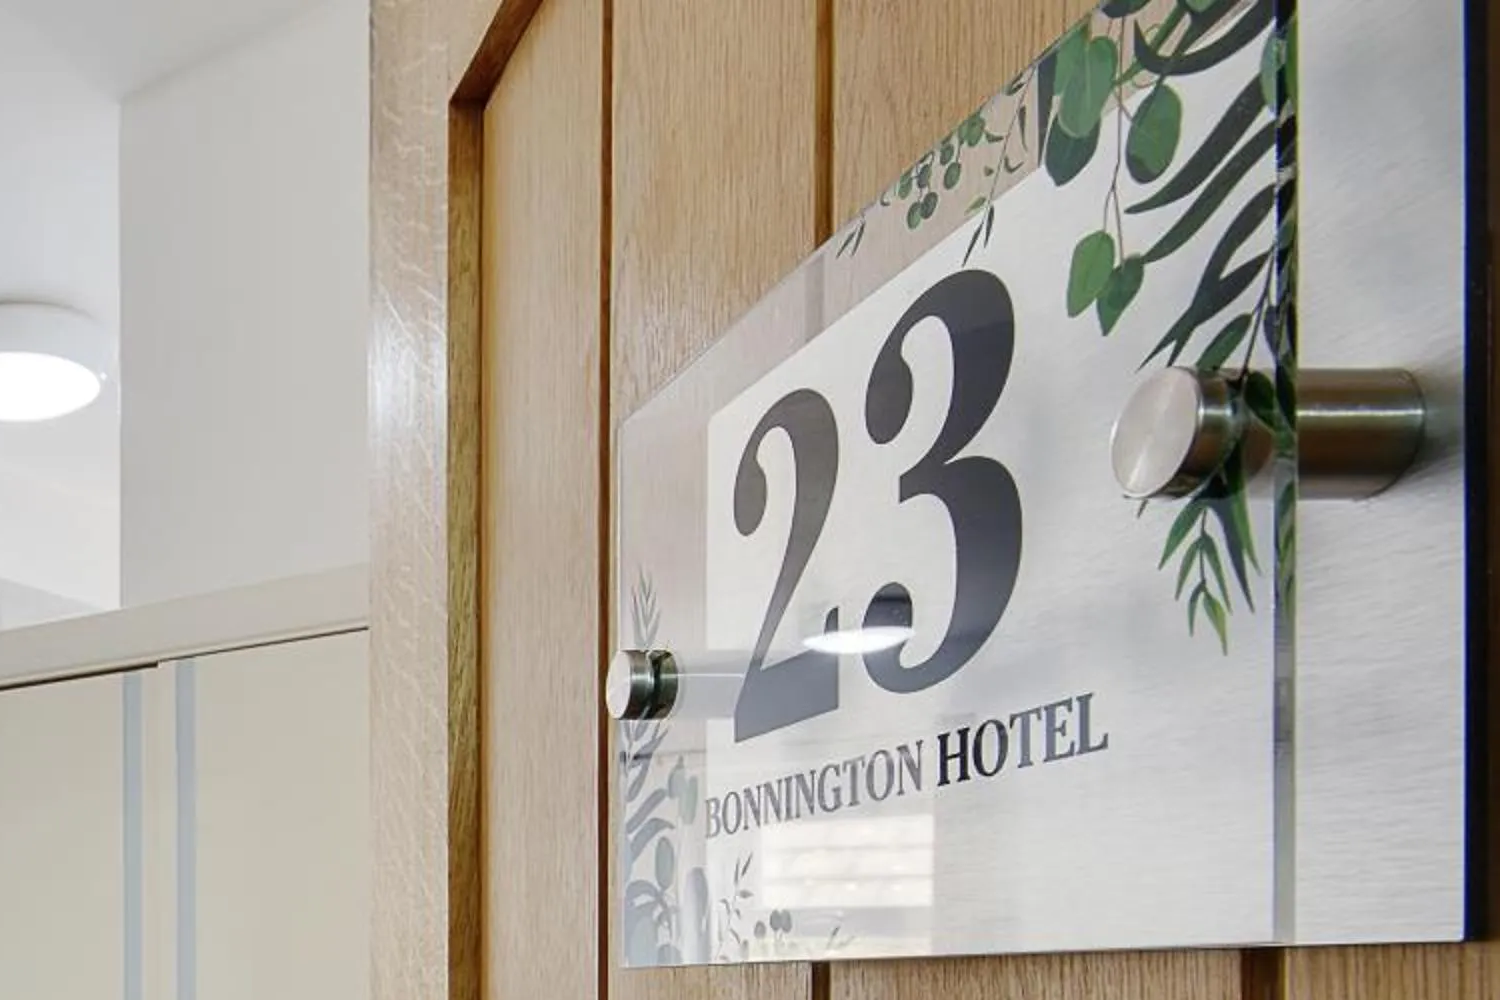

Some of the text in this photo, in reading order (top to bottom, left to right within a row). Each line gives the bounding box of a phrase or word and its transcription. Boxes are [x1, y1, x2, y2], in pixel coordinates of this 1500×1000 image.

[733, 268, 1023, 743] 23
[704, 692, 1109, 839] BONNINGTON HOTEL
